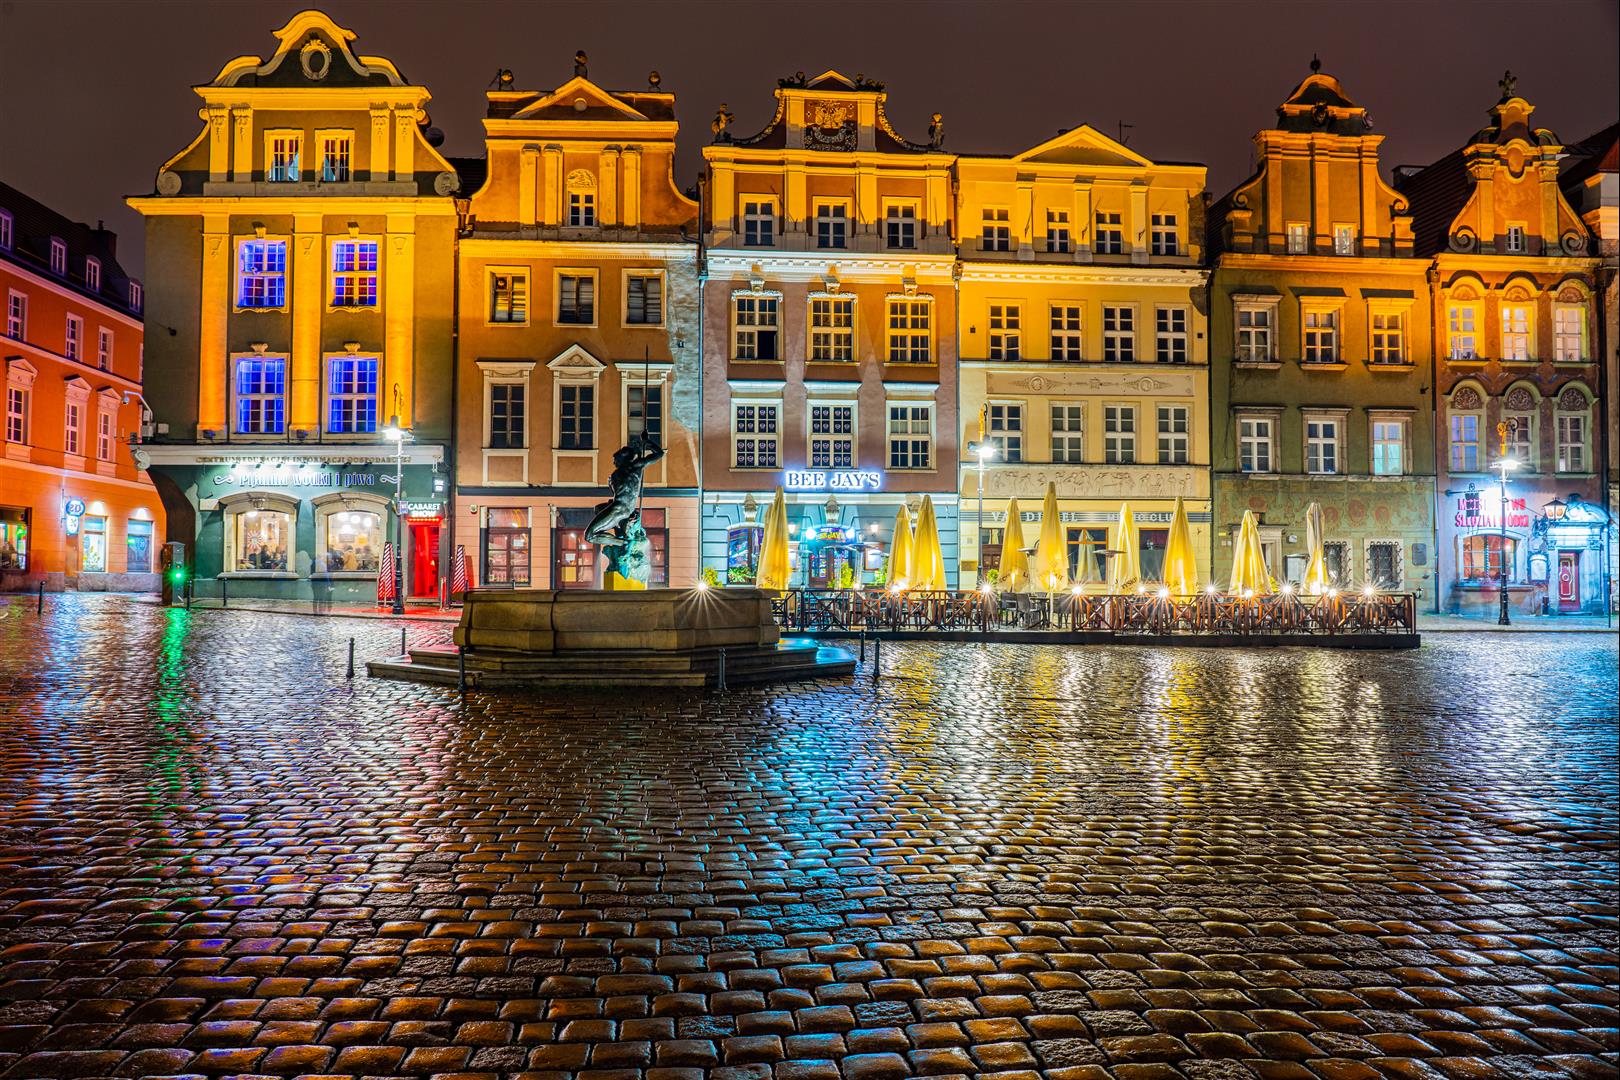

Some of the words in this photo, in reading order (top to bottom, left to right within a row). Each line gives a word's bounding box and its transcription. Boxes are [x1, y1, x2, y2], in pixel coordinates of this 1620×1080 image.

[335, 472, 341, 486] i
[345, 472, 375, 488] piwa
[787, 472, 824, 486] BEE
[832, 472, 880, 488] JAY'S
[408, 503, 441, 511] CABARET
[1025, 512, 1077, 521] DIEL
[1150, 513, 1173, 521] CLU
